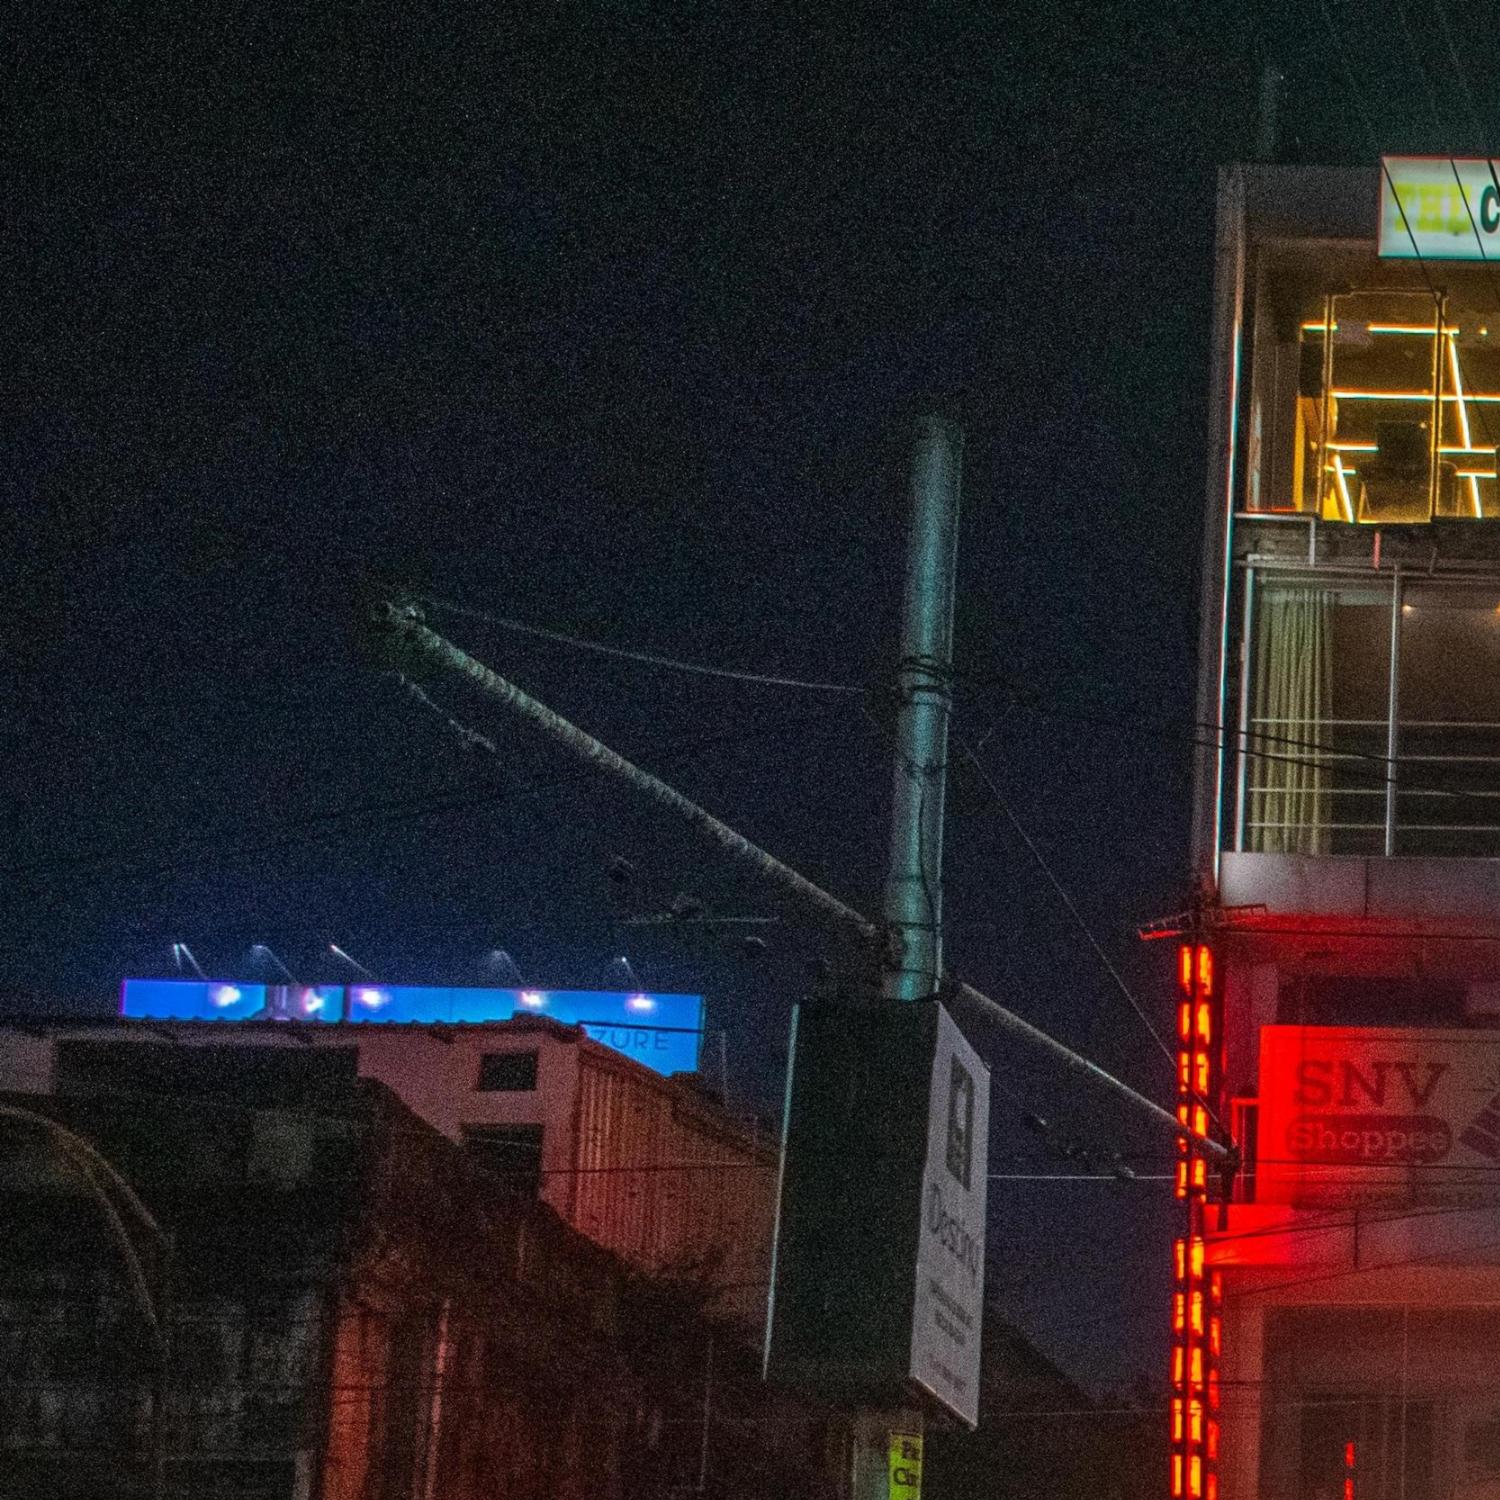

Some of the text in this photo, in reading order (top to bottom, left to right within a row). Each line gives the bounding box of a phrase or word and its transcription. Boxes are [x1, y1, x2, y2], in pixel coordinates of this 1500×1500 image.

[1393, 183, 1472, 234] THE
[1293, 1059, 1451, 1108] SNV
[1287, 1121, 1448, 1160] Shoppee
